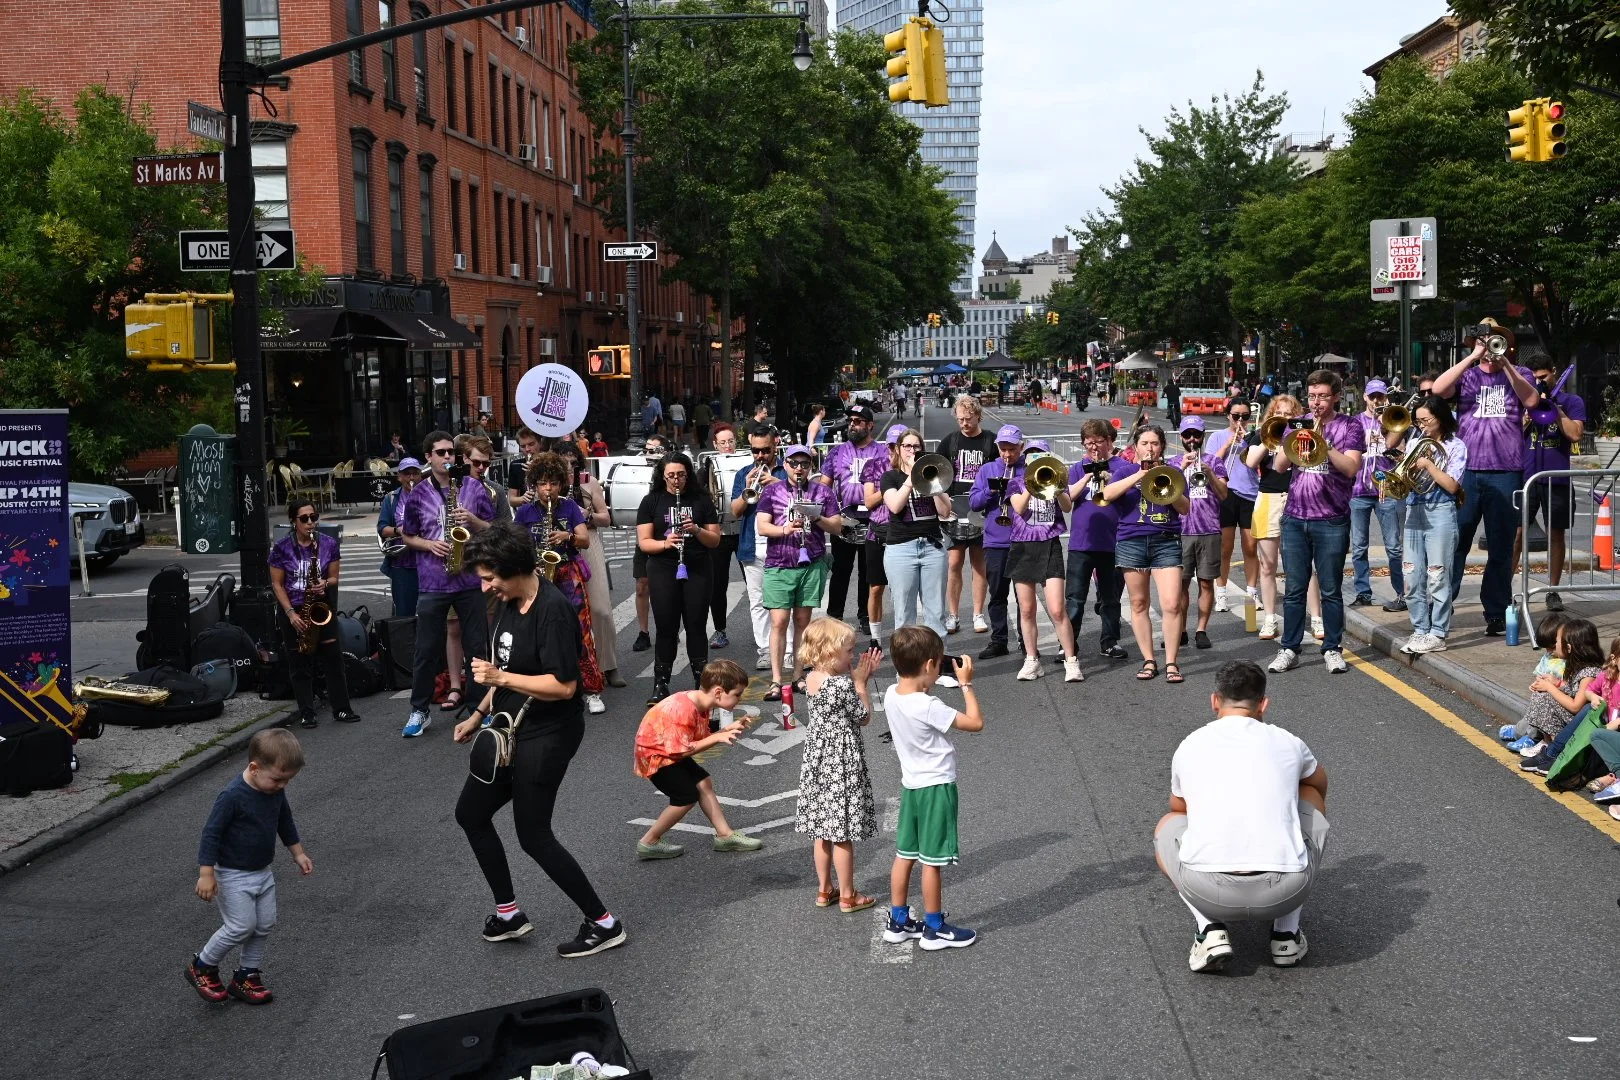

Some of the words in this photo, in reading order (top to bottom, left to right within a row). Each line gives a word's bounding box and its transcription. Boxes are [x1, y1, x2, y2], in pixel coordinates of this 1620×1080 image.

[190, 109, 218, 138] Vanderbilt
[219, 119, 226, 140] Av
[136, 164, 150, 183] St
[155, 162, 192, 182] Marks
[197, 161, 214, 180] Av
[1390, 237, 1415, 247] CASH
[197, 243, 230, 258] ONE
[256, 242, 275, 258] AY
[611, 248, 627, 256] ONE
[633, 247, 649, 255] WAY
[1390, 246, 1420, 256] CARS
[1392, 256, 1419, 264] (516)
[1390, 271, 1421, 279] 0007
[545, 403, 566, 418] BAND
[48, 439, 62, 448] 20
[48, 447, 62, 456] 24
[0, 459, 22, 468] USIC
[23, 459, 62, 467] FESTIVAL
[20, 486, 62, 498] 14TH
[50, 499, 61, 507] BK
